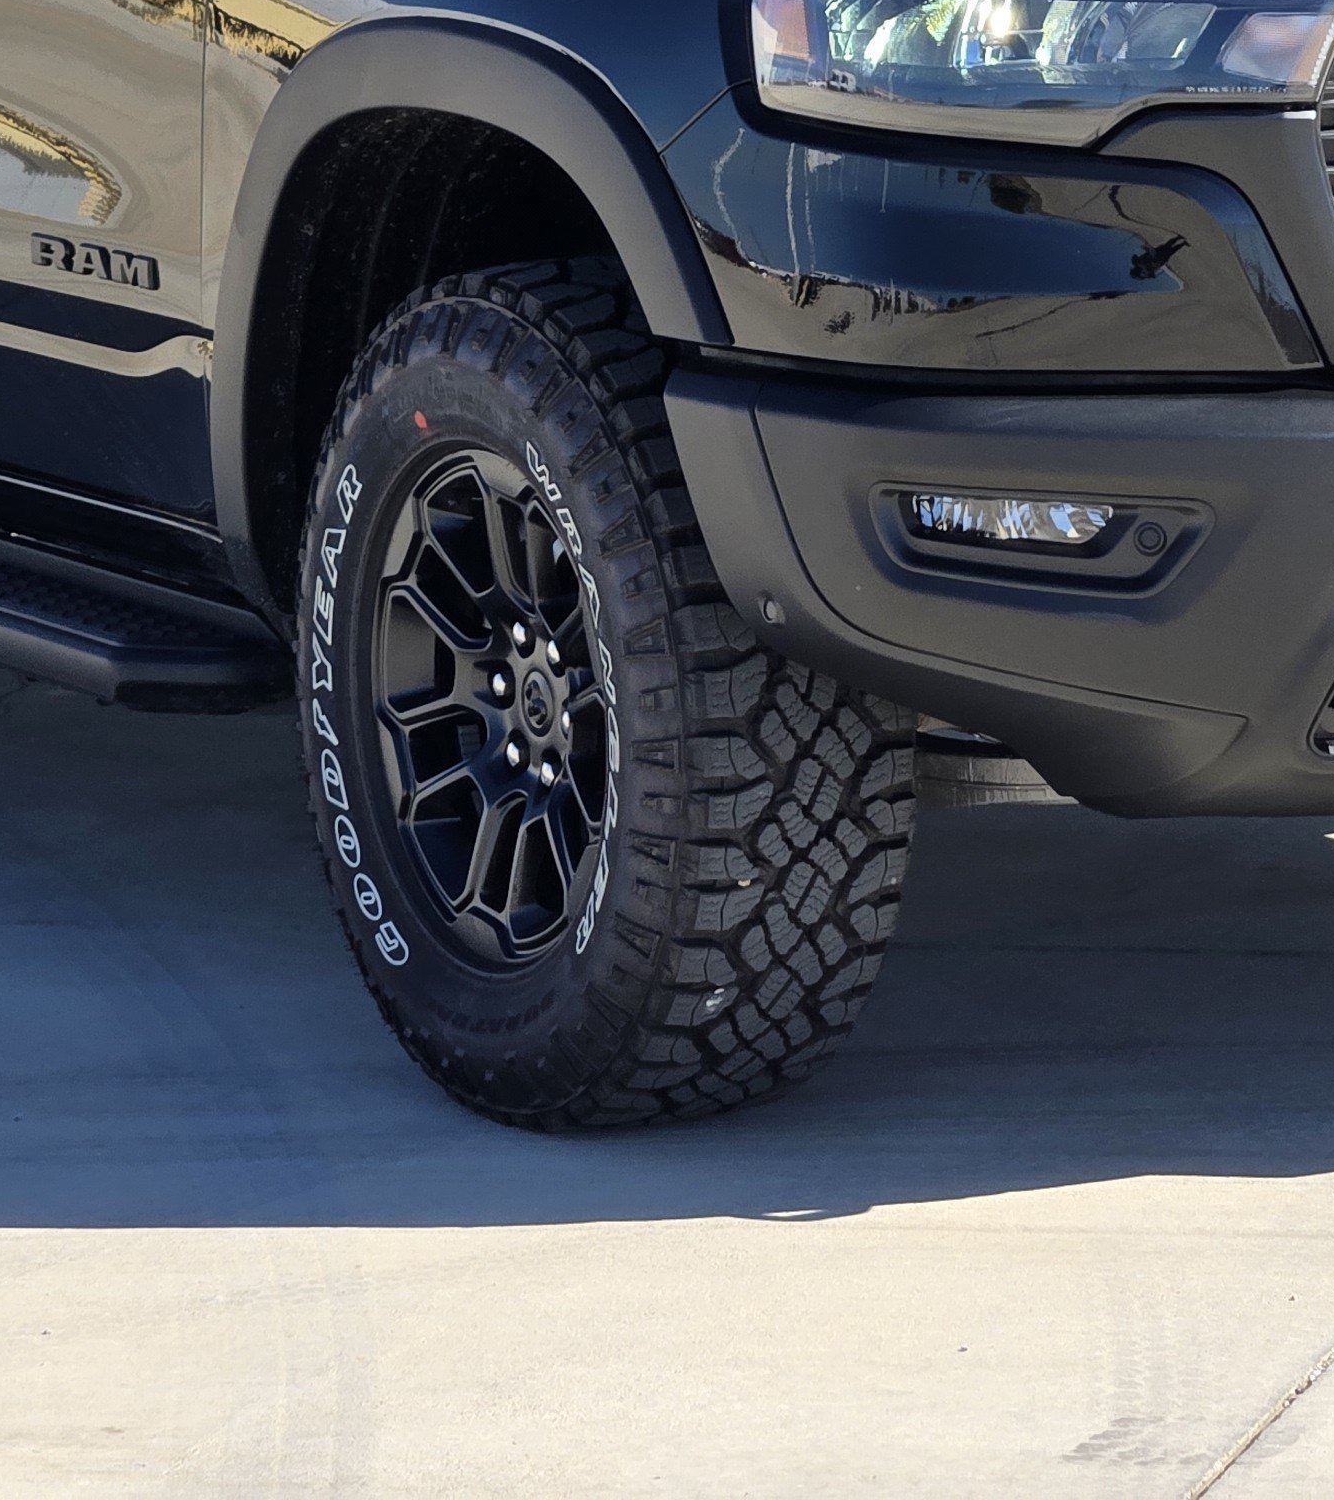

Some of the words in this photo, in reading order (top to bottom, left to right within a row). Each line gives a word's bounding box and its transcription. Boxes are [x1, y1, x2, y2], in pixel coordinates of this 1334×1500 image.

[31, 232, 161, 290] RAM
[313, 463, 409, 966] GOODYEAR
[526, 440, 620, 954] WRANGLER
